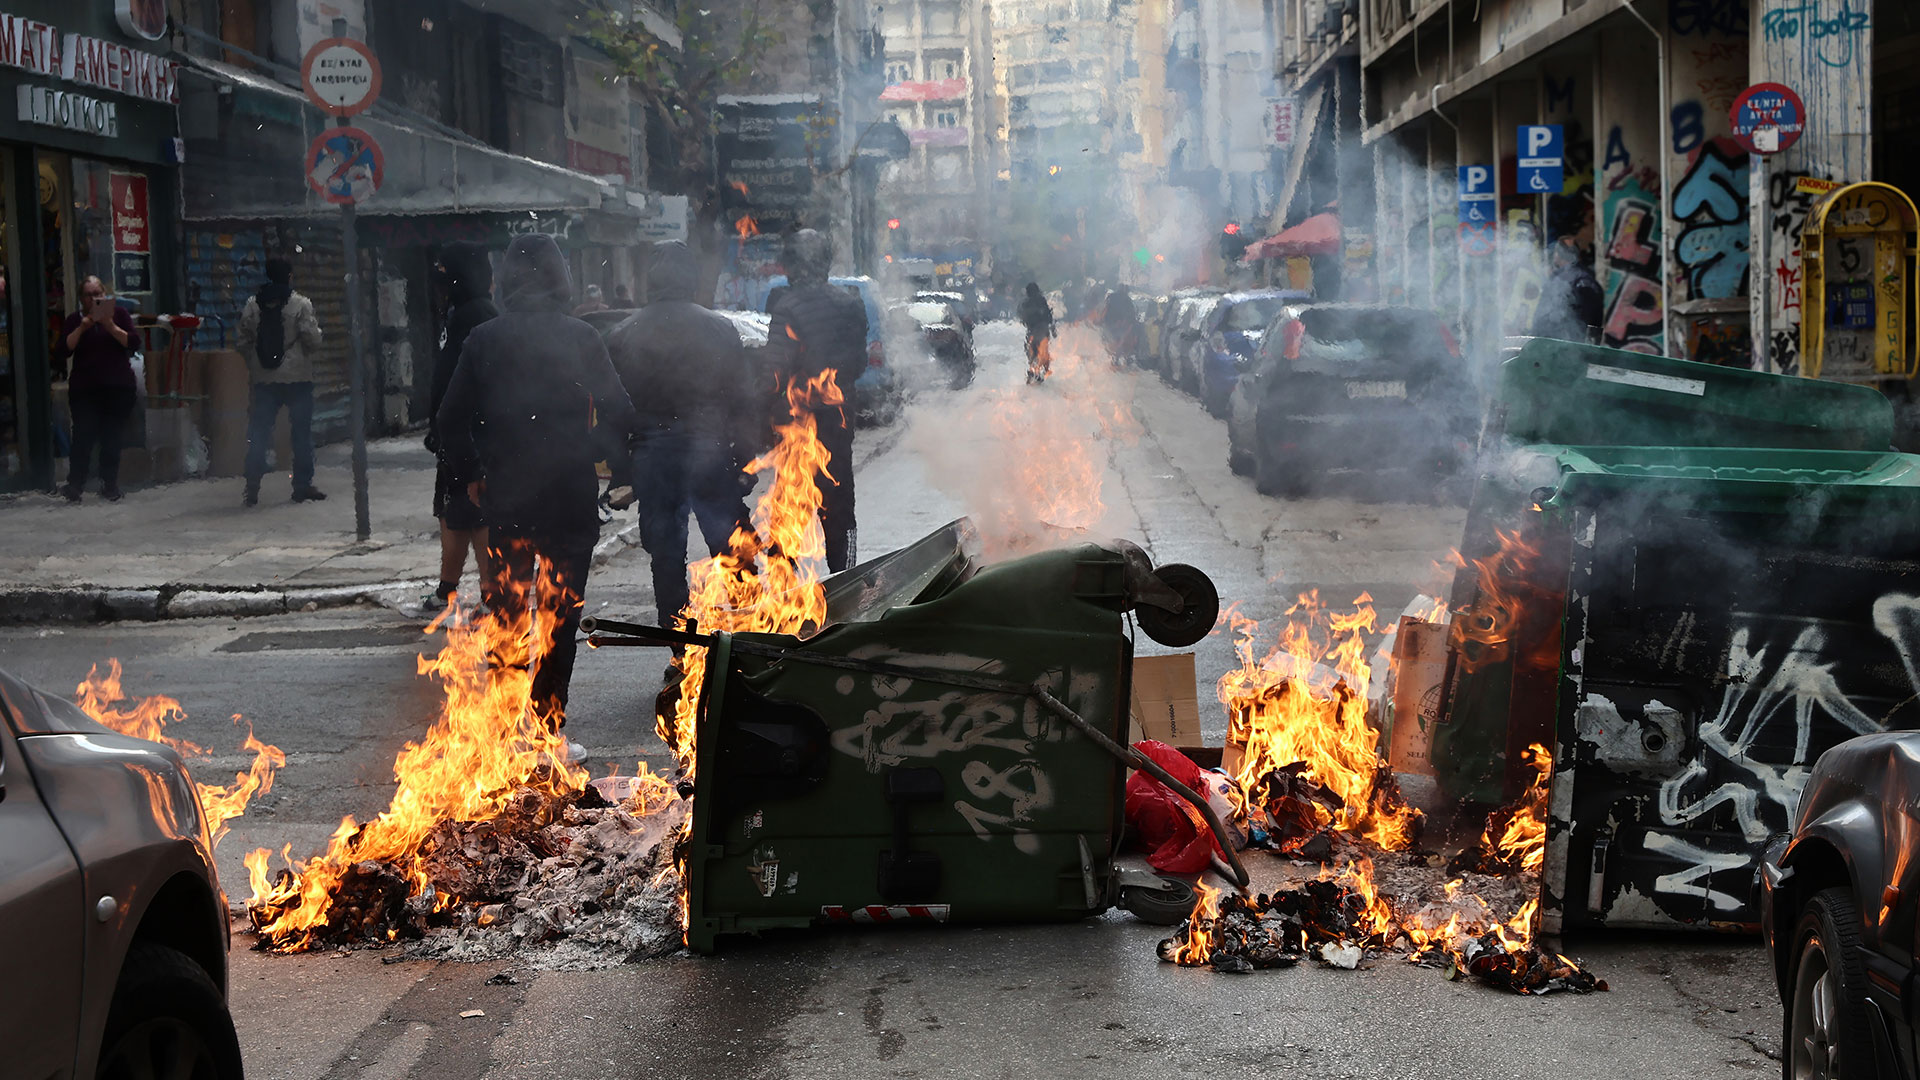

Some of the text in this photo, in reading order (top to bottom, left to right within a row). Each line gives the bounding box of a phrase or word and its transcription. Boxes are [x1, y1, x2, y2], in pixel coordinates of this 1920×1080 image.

[75, 35, 181, 104] ΑΜΕΡΙΚΗΣ
[1528, 126, 1552, 157] P
[1467, 167, 1487, 192] P
